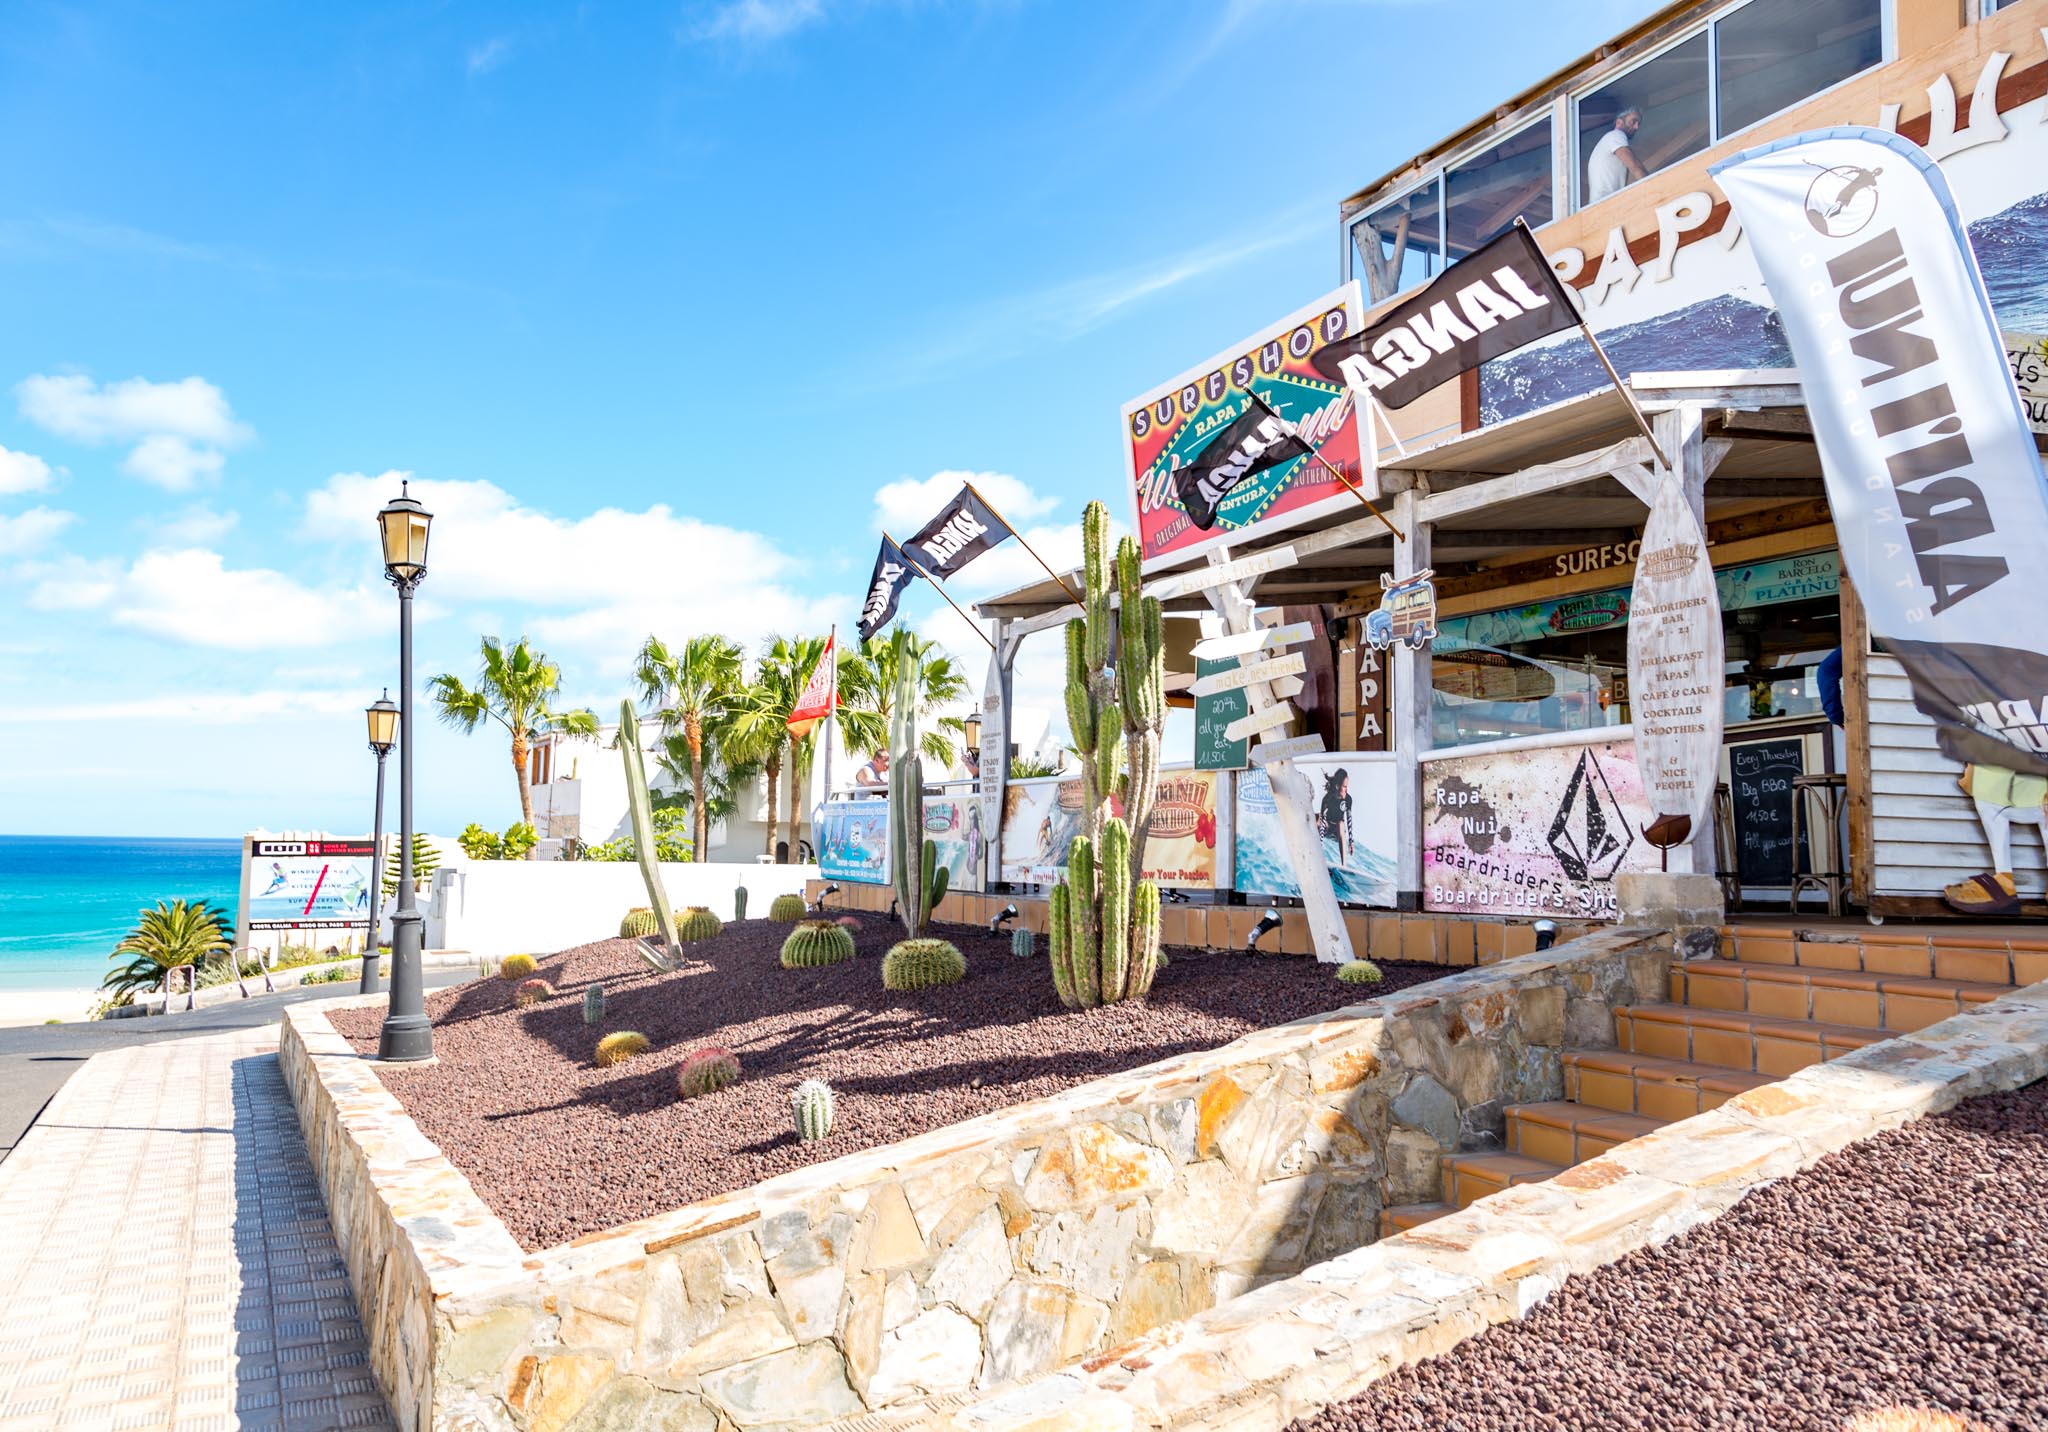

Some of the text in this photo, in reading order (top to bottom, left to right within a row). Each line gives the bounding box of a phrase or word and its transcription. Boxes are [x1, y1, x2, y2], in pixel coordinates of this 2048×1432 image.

[1134, 309, 1345, 436] SURFSHOP
[1195, 405, 1237, 438] RAPA
[1228, 475, 1259, 497] ERTE
[1555, 539, 1642, 577] SURFSC
[1793, 557, 1816, 569] RON
[1784, 575, 1824, 586] GRAN
[1755, 578, 1839, 601] PLATINU
[1632, 596, 1708, 618] BOARDRIDERS
[1662, 614, 1684, 625] BAR
[1641, 651, 1704, 667] BREAKFAST
[1655, 670, 1690, 682] TAPAS
[1671, 689, 1680, 698] &
[1682, 686, 1712, 697] CAKE
[1643, 706, 1703, 719] COCKTAILS
[1199, 717, 1213, 734] all
[1643, 724, 1706, 737] SMOOTHIES
[1669, 755, 1678, 765] &
[1736, 748, 1799, 770] Every Thursday
[1662, 768, 1688, 778] NICE
[1655, 780, 1695, 791] PEOPLE
[1741, 778, 1788, 807] Big BBQ
[1436, 788, 1481, 808] Rapa
[1463, 817, 1497, 836] Nui
[1156, 868, 1177, 880] Your
[1434, 846, 1562, 895] Boardriders
[1433, 886, 1616, 909] Boardriders Sho
